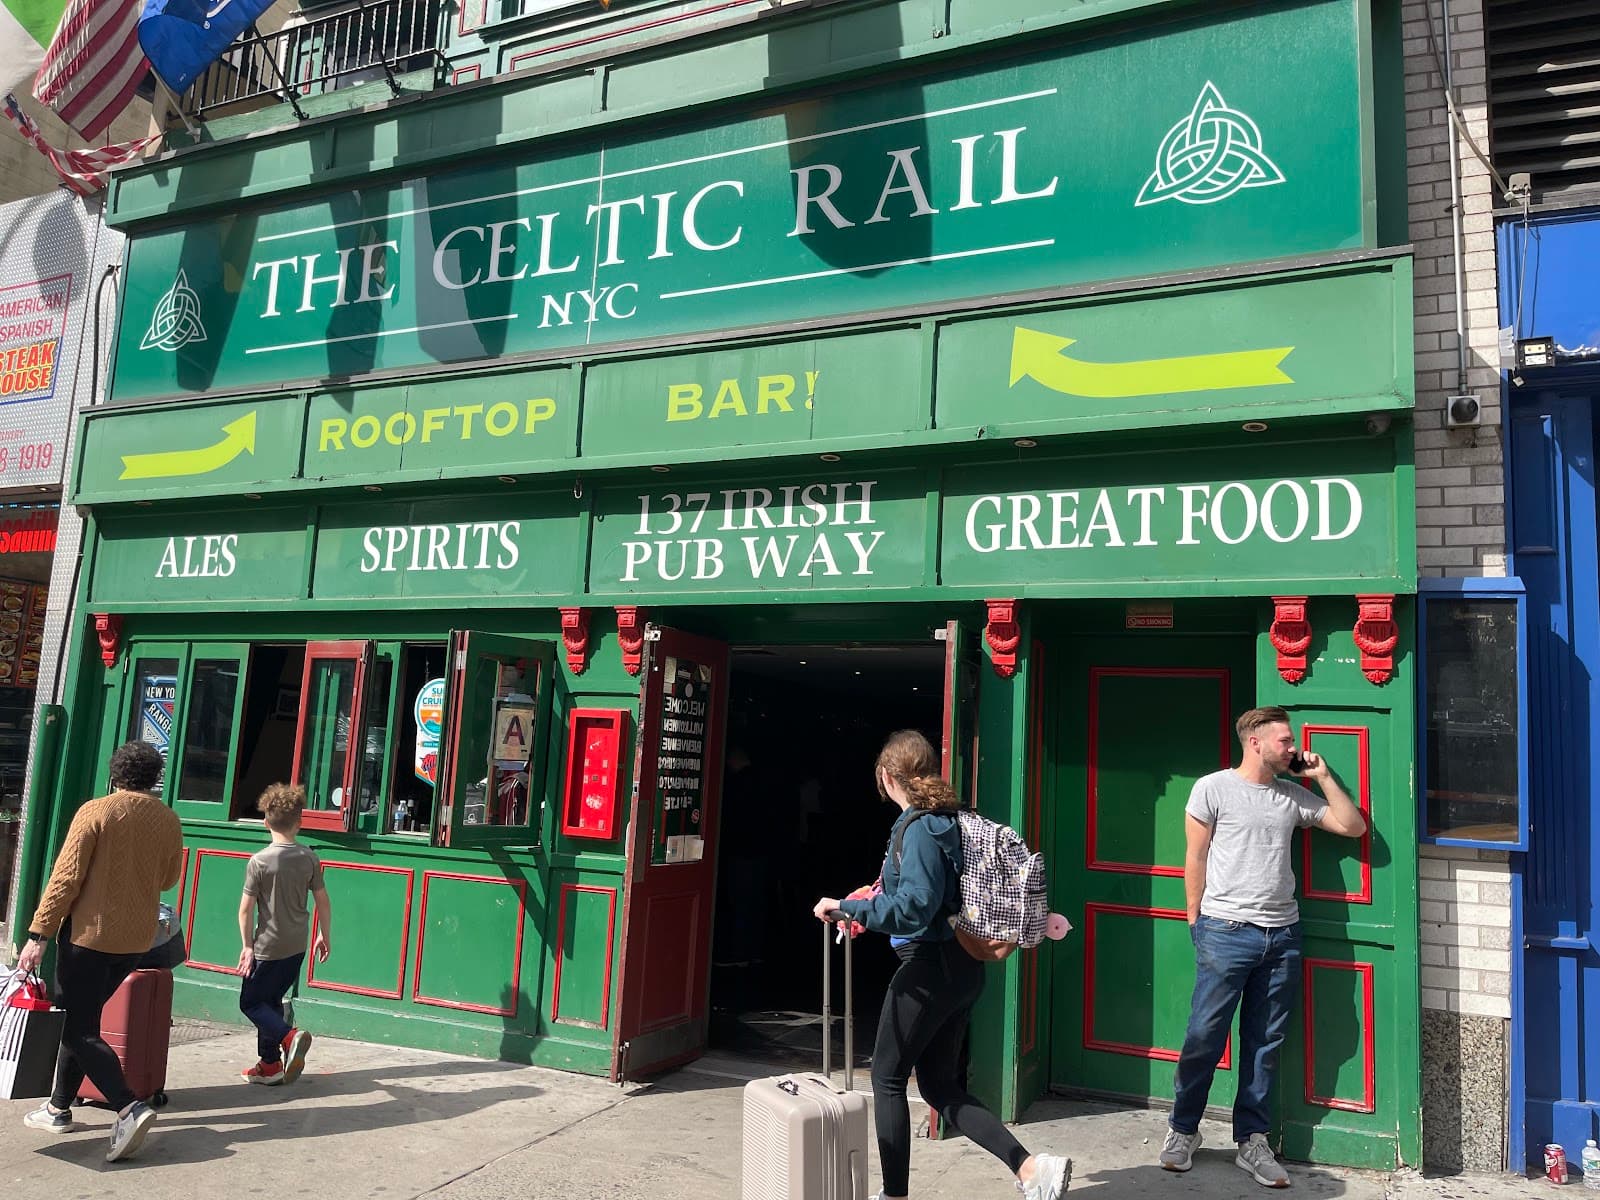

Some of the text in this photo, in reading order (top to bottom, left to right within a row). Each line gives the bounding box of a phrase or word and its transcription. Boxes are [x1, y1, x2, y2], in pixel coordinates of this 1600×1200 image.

[253, 126, 1059, 318] THE CELTIC RAIL
[0, 292, 63, 318] AMERICAN
[537, 283, 639, 328] NYC
[0, 317, 53, 342] SPANISH
[0, 366, 52, 395] OUSE
[319, 370, 820, 452] ROOFTOP BAR!
[634, 480, 878, 535] 137 IRISH
[965, 478, 1363, 553] GREAT FOOD
[155, 534, 238, 578] ALES
[360, 522, 521, 573] SPIRITS
[619, 531, 885, 582] PUB WAY
[145, 687, 175, 699] NEW YO
[422, 697, 443, 705] CRUI
[432, 687, 443, 695] SU
[148, 703, 172, 736] RANGE
[503, 715, 525, 745] A
